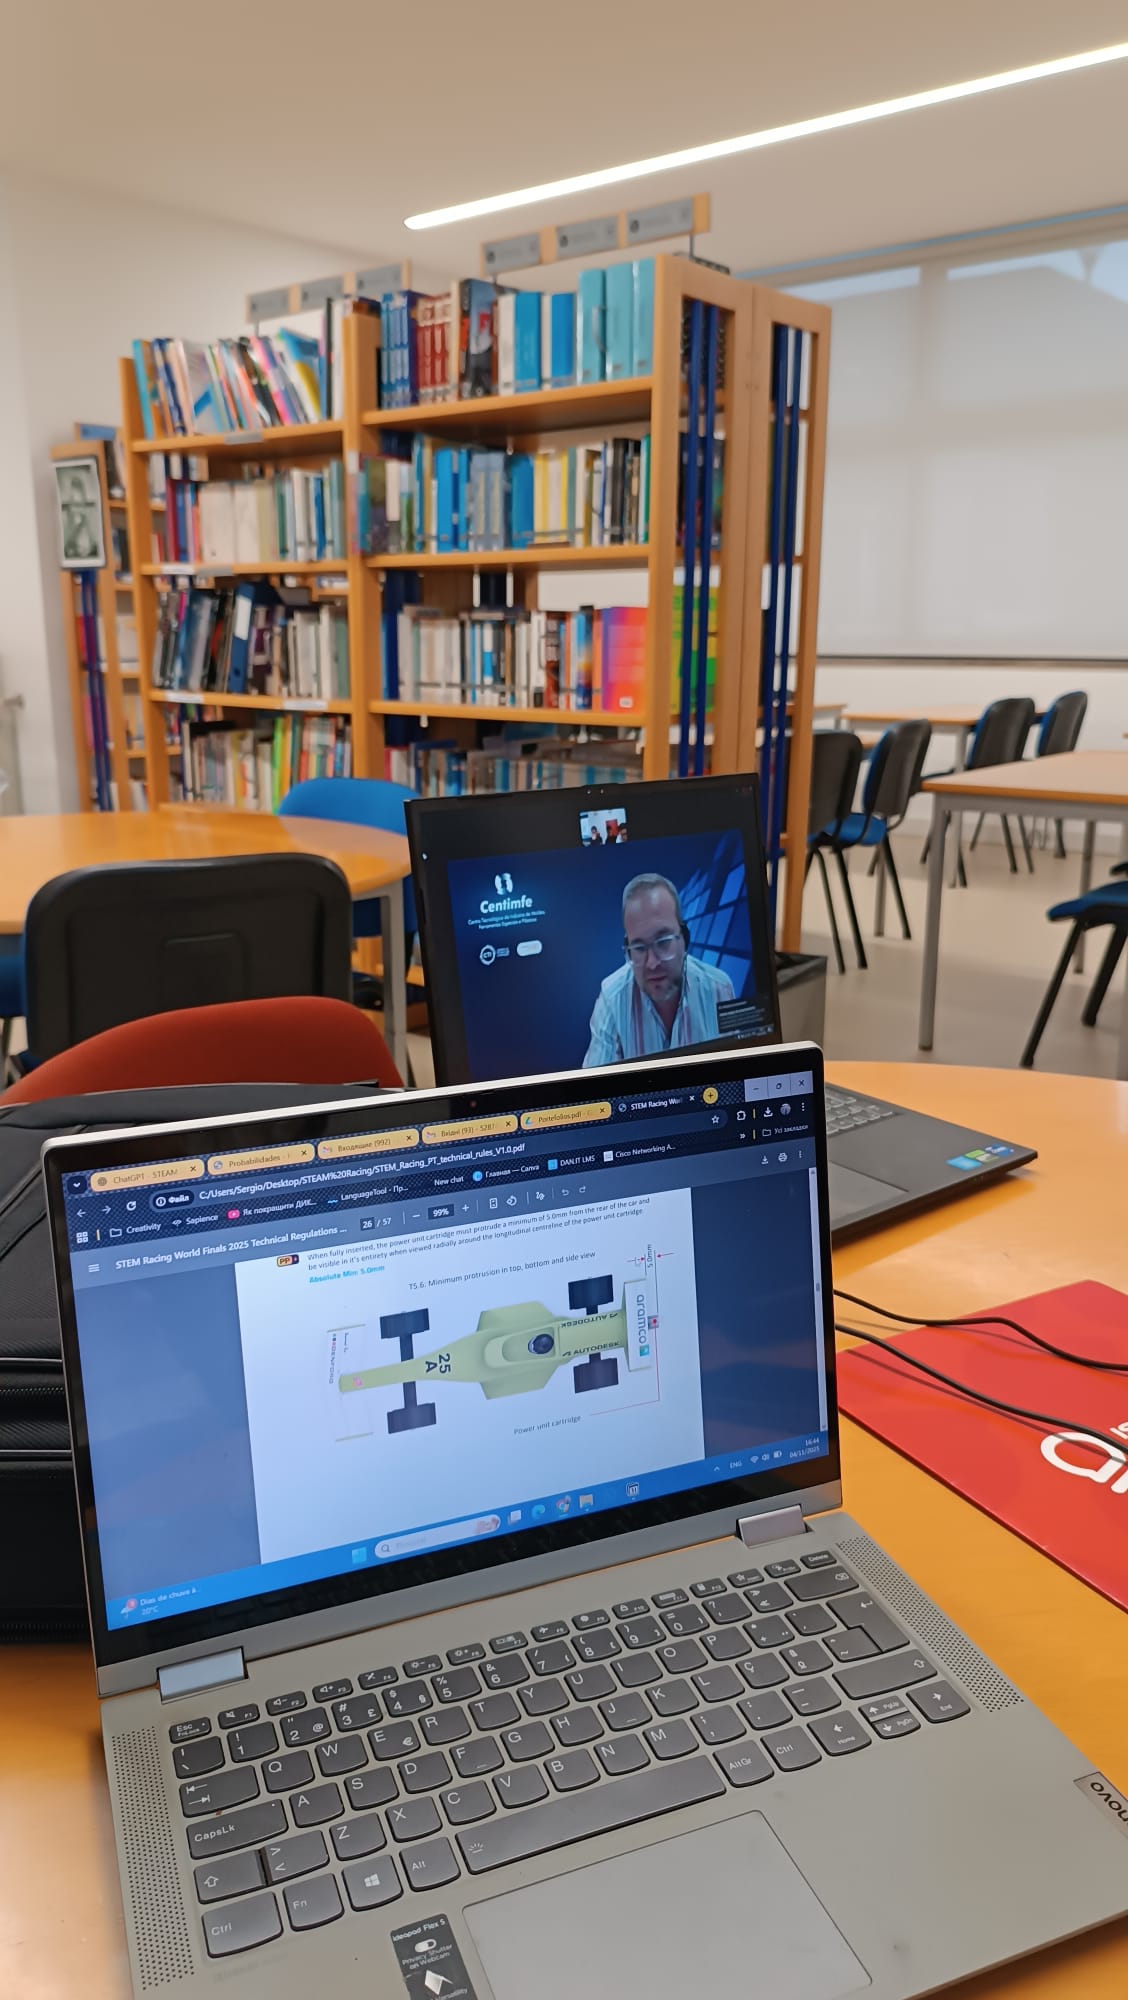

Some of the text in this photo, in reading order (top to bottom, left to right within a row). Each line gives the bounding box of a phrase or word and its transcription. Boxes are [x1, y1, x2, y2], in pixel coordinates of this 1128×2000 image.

[480, 894, 533, 914] Centimfe
[631, 1099, 667, 1111] STEM Racing
[374, 1139, 391, 1150] (992)
[615, 1145, 666, 1158] Cisco Networking
[228, 1153, 280, 1168] Probabilidades
[582, 1154, 596, 1163] LMS
[199, 1143, 526, 1200] C:/Users/Sergio/Desktop/STEAM%20Racing/STEM_Racing_PT_technical_rules_V1.0.pdf
[520, 1164, 540, 1173] Canva
[113, 1172, 145, 1184] ChatGPT
[434, 1175, 465, 1186] New chat
[168, 1194, 190, 1204] Файл
[341, 1187, 387, 1201] LanguageTool
[432, 1207, 449, 1218] 99%
[186, 1214, 219, 1226] Sapience
[362, 1217, 392, 1229] 26 57
[126, 1222, 161, 1235] Creativity
[307, 1252, 328, 1262] When
[329, 1248, 344, 1260] fully
[376, 1241, 388, 1249] the
[389, 1238, 410, 1249] power
[411, 1235, 425, 1243] unit
[425, 1231, 454, 1243] cartridge
[456, 1227, 472, 1236] must
[473, 1222, 501, 1234] protrude
[507, 1217, 538, 1227] minimum
[569, 1208, 584, 1217] from
[584, 1206, 596, 1214] the
[638, 1197, 650, 1206] and
[308, 1208, 643, 1271] be visible entirety when viewed radially around the longitudinal centreline the power unit cartridge
[115, 1227, 338, 1270] STEM Racing World Finals 2025 Technical Regulations
[428, 1275, 463, 1287] Minimum
[463, 1268, 501, 1282] protrusion
[524, 1259, 550, 1270] bottom
[551, 1256, 564, 1265] and
[565, 1253, 579, 1263] side
[580, 1251, 596, 1260] view
[636, 1294, 647, 1344] aramco
[573, 1341, 620, 1355] AUTODESK
[425, 1360, 438, 1373] A
[438, 1353, 451, 1374] 25
[513, 1414, 582, 1436] Power unit cartridge
[808, 1552, 830, 1562] Delete
[629, 1634, 639, 1644] 9
[706, 1635, 717, 1646] P
[584, 1647, 594, 1656] 8
[663, 1647, 677, 1658] O
[537, 1660, 546, 1671] 7
[744, 1662, 755, 1674] Ç
[491, 1674, 501, 1684] 6
[570, 1673, 584, 1685] U
[698, 1676, 711, 1687] L
[442, 1687, 453, 1698] 5
[523, 1688, 534, 1699] Y
[652, 1688, 666, 1700] K
[393, 1701, 402, 1711] 4
[475, 1702, 485, 1713] T
[608, 1702, 616, 1714] J
[883, 1701, 900, 1710] PgUp
[940, 1703, 953, 1712] End
[342, 1715, 352, 1726] 3
[425, 1716, 438, 1728] R
[556, 1716, 571, 1730] H
[896, 1717, 914, 1727] PgDn
[176, 1723, 193, 1733] Esc
[290, 1730, 300, 1741] 2
[373, 1730, 387, 1743] E
[507, 1731, 522, 1743] G
[650, 1728, 667, 1742] M
[837, 1735, 856, 1745] Home
[237, 1745, 245, 1755] 1
[321, 1743, 339, 1757] W
[455, 1747, 467, 1760] F
[600, 1744, 616, 1757] N
[776, 1743, 794, 1754] Ctrl
[268, 1761, 282, 1773] Q
[404, 1762, 417, 1775] D
[551, 1760, 565, 1773] B
[728, 1756, 752, 1771] AltGr
[351, 1778, 364, 1790] S
[500, 1775, 512, 1788] V
[297, 1795, 310, 1808] A
[447, 1792, 461, 1805] C
[392, 1807, 407, 1822] X
[194, 1824, 236, 1843] CapsLk
[336, 1826, 350, 1840] Z
[412, 1860, 427, 1872] Alt
[292, 1899, 308, 1910] Fn
[211, 1923, 233, 1937] Ctrl
[423, 1922, 440, 1932] Flex
[401, 1944, 453, 1966] Privacy Shutter
[409, 1952, 450, 1970] on Webcam
